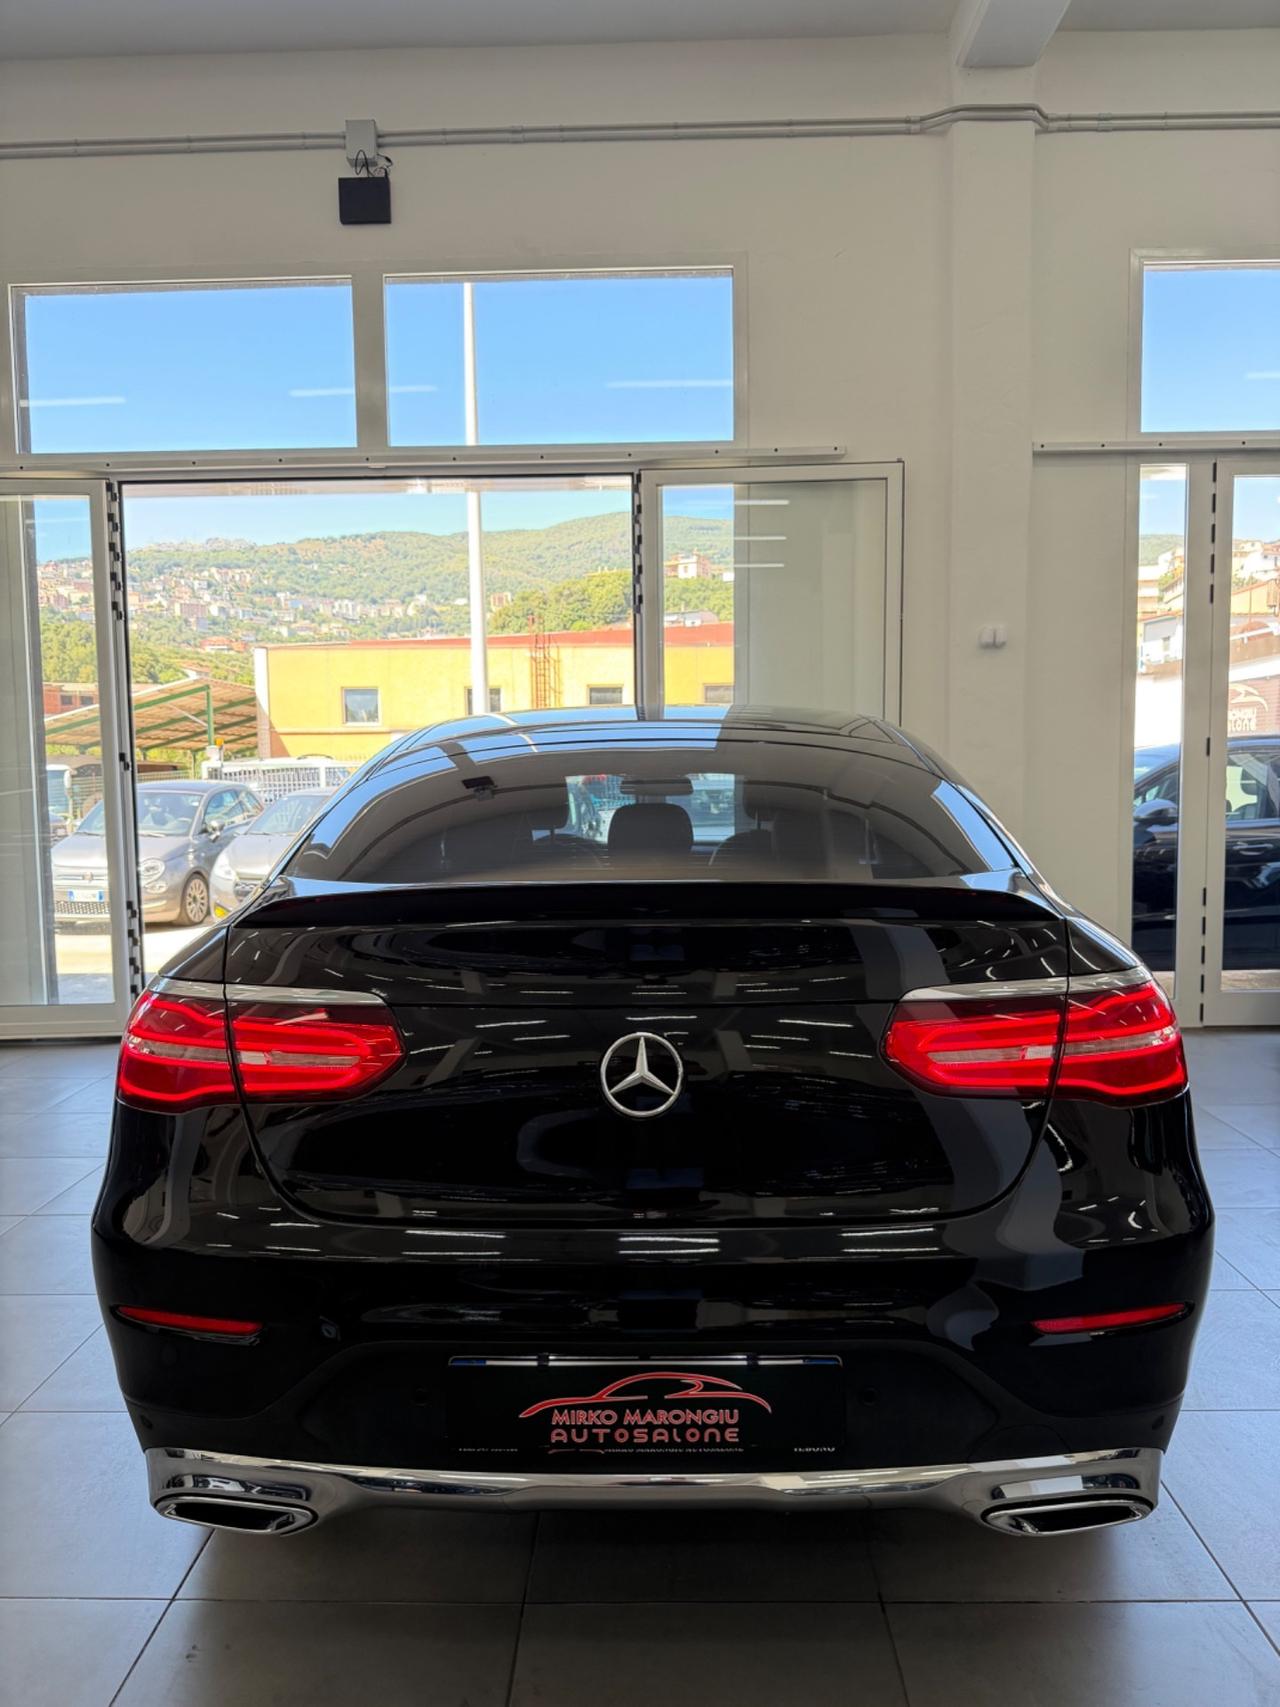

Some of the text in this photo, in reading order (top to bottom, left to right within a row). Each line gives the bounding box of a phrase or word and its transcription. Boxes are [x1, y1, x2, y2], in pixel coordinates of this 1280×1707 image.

[551, 1408, 740, 1426] MIRKO MARONGIU
[550, 1428, 740, 1444] AUTOSALONE
